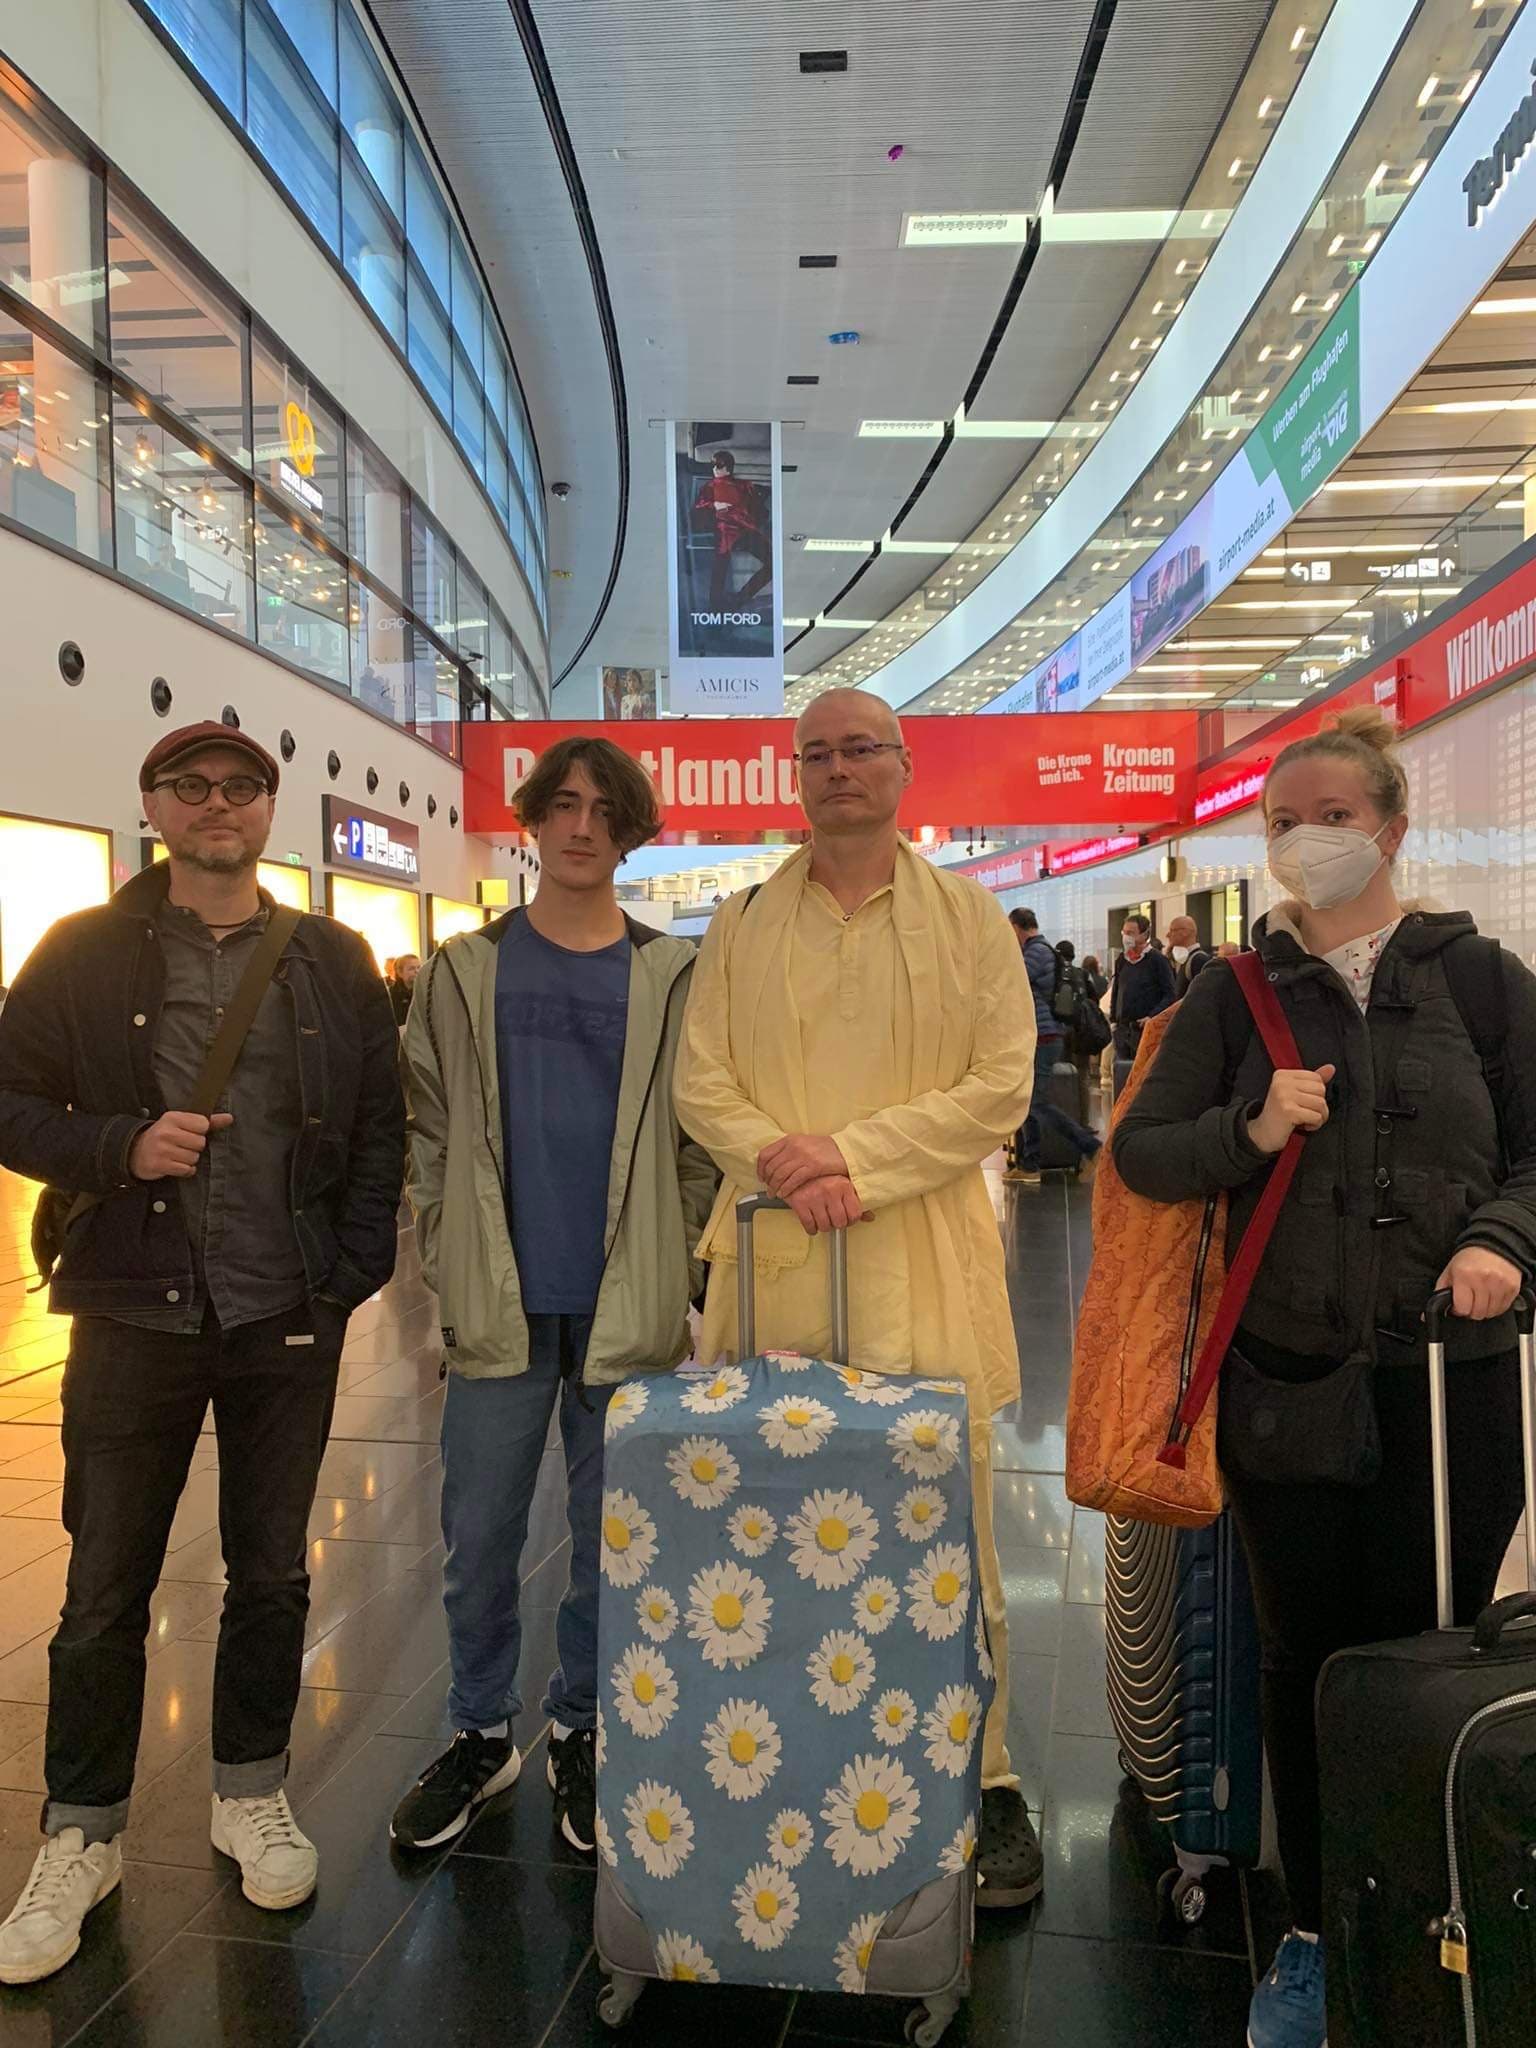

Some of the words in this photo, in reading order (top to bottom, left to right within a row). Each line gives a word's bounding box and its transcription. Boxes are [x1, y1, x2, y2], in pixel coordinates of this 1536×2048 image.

[1272, 399, 1298, 443] Werben
[1299, 383, 1311, 409] am
[1311, 328, 1349, 392] Flughafen
[1300, 421, 1322, 457] airport
[1300, 446, 1322, 481] media
[1218, 496, 1275, 573] airport-media.at
[690, 612, 721, 626] TOM
[723, 612, 762, 626] FORD
[695, 678, 760, 693] AMICIS
[1037, 755, 1057, 771] Die
[1057, 753, 1092, 769] Krone
[1103, 743, 1175, 767] Kronen
[1039, 770, 1061, 786] und
[1062, 767, 1085, 784] ich.
[1103, 769, 1175, 796] Zeitung
